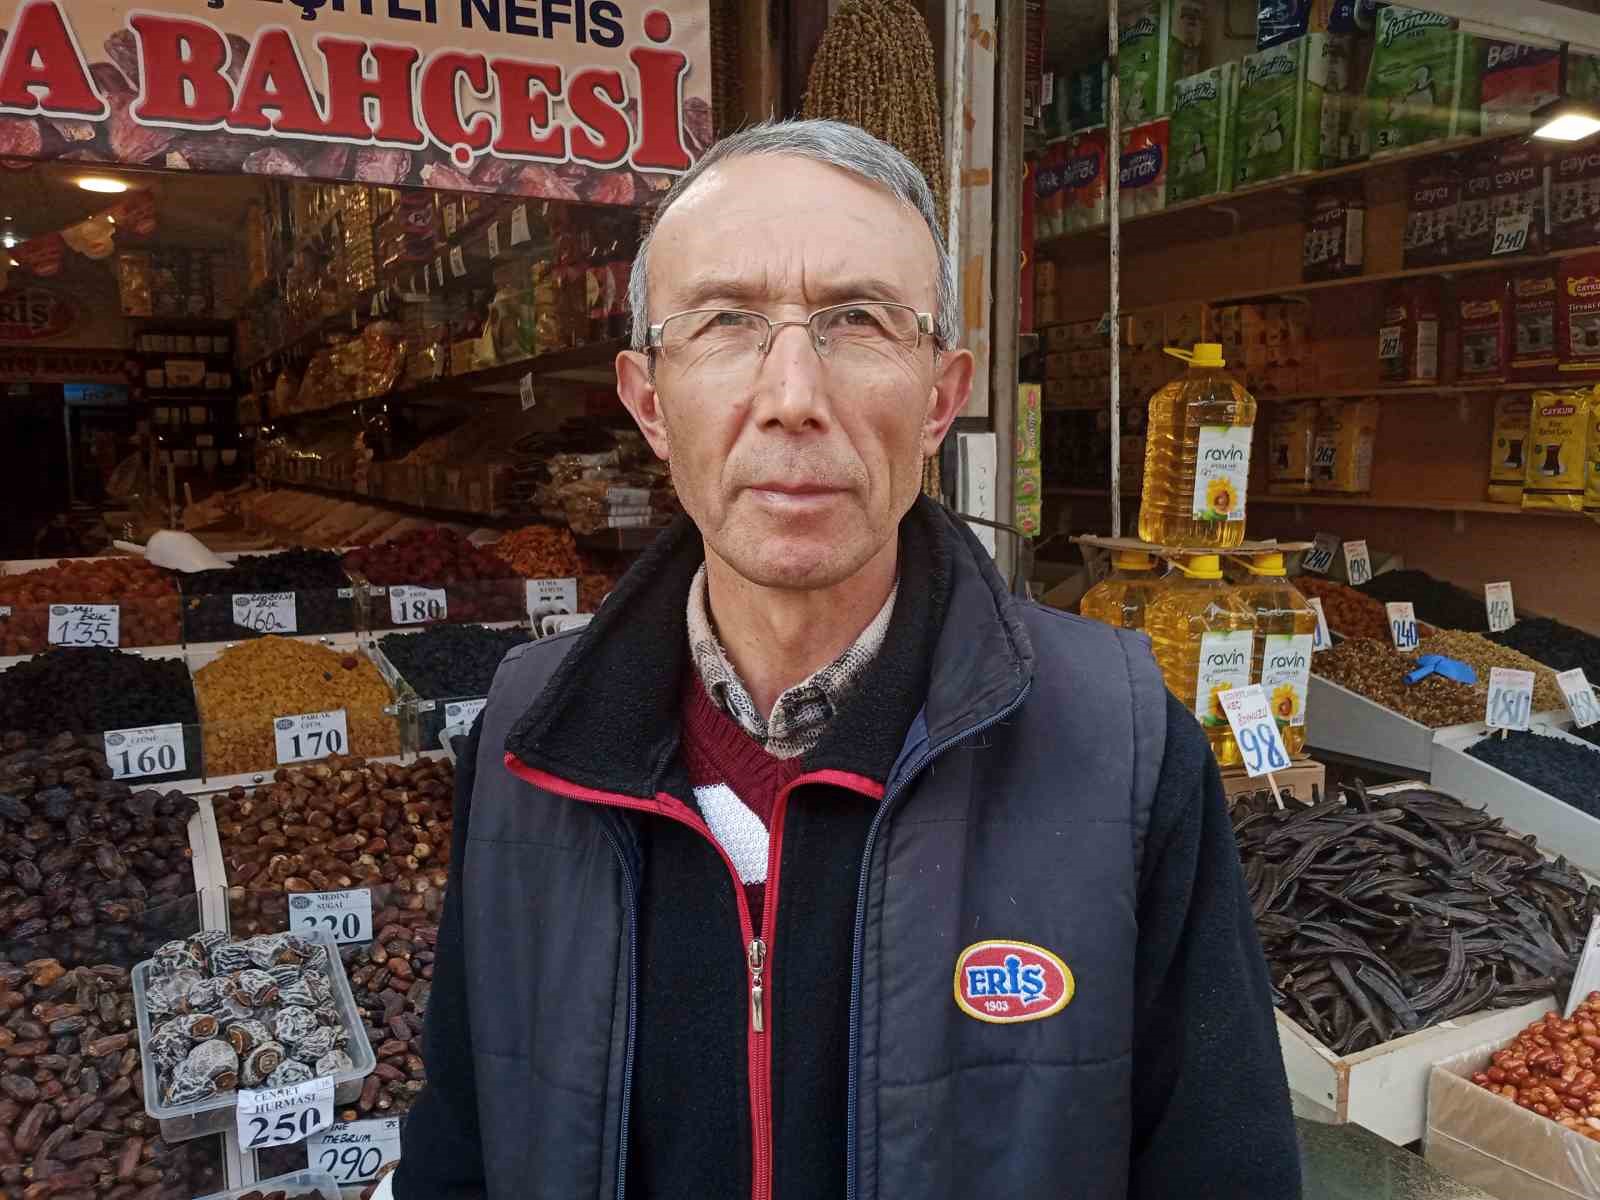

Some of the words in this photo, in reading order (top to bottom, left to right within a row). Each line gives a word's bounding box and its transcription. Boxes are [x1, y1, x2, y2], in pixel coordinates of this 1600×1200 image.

[131, 9, 690, 171] BAHÇESİ
[1204, 444, 1243, 461] ravin
[400, 599, 441, 621] 180
[1393, 619, 1418, 647] 240
[1207, 648, 1245, 666] ravin
[1270, 652, 1305, 669] ravin
[291, 728, 342, 758] 170
[1239, 723, 1285, 772] 98
[118, 744, 176, 774] 160
[966, 956, 1045, 1004] ERİŞ
[984, 1000, 1008, 1012] 1903
[254, 1086, 298, 1101] CENNET
[248, 1107, 321, 1147] 250
